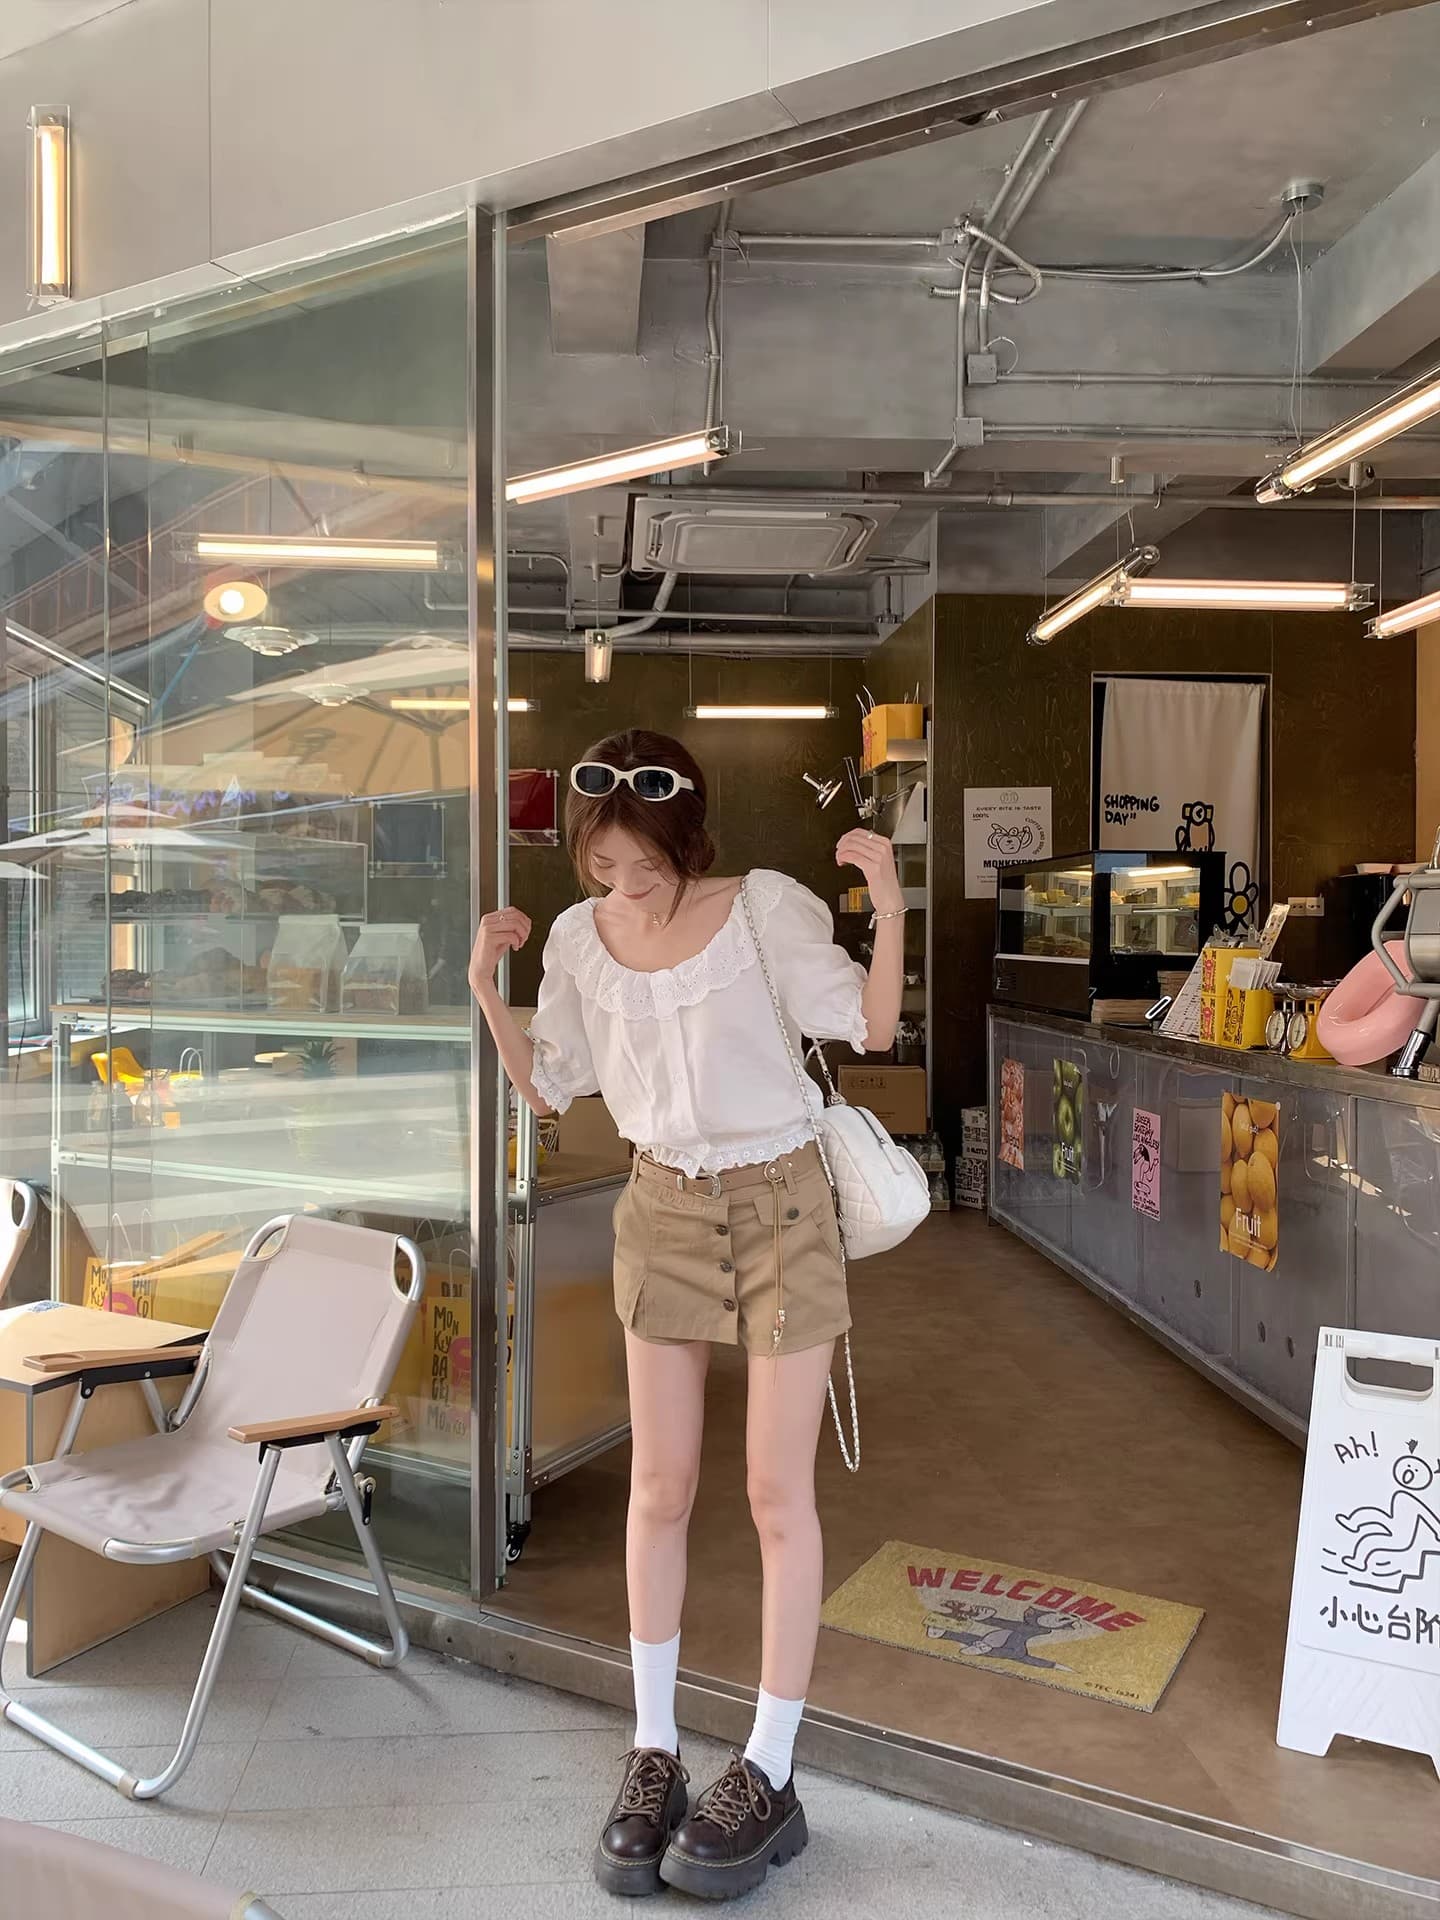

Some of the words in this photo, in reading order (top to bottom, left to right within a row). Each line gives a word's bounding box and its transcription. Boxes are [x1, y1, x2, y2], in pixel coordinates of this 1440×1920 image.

[1104, 794, 1160, 812] SHOPPING
[1235, 1207, 1262, 1237] Fruit
[434, 1305, 459, 1336] MON
[432, 1354, 448, 1378] BA
[1334, 1430, 1379, 1464] Ah!
[907, 1566, 1146, 1632] WELCOME
[1320, 1596, 1440, 1644] 小心台阶
